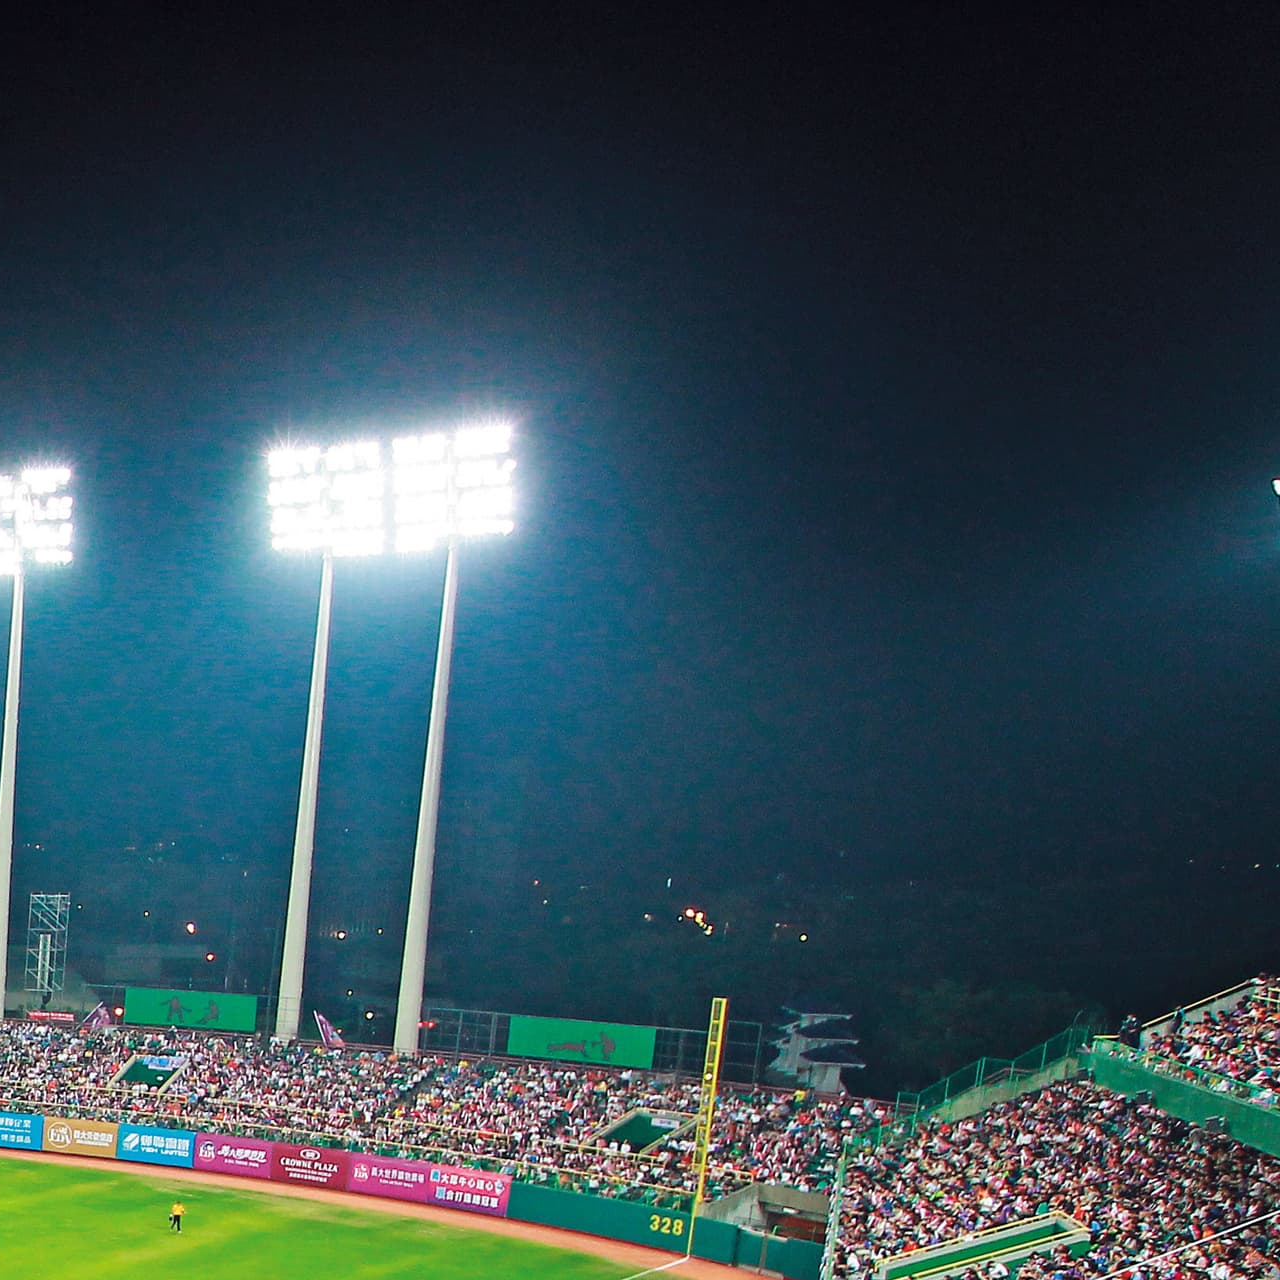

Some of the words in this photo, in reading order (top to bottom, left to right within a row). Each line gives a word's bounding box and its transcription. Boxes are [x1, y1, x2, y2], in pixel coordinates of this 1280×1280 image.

[160, 1148, 190, 1157] UNITED
[280, 1157, 312, 1169] CROWNE
[314, 1161, 338, 1173] PLAZA
[649, 1214, 683, 1236] 328
